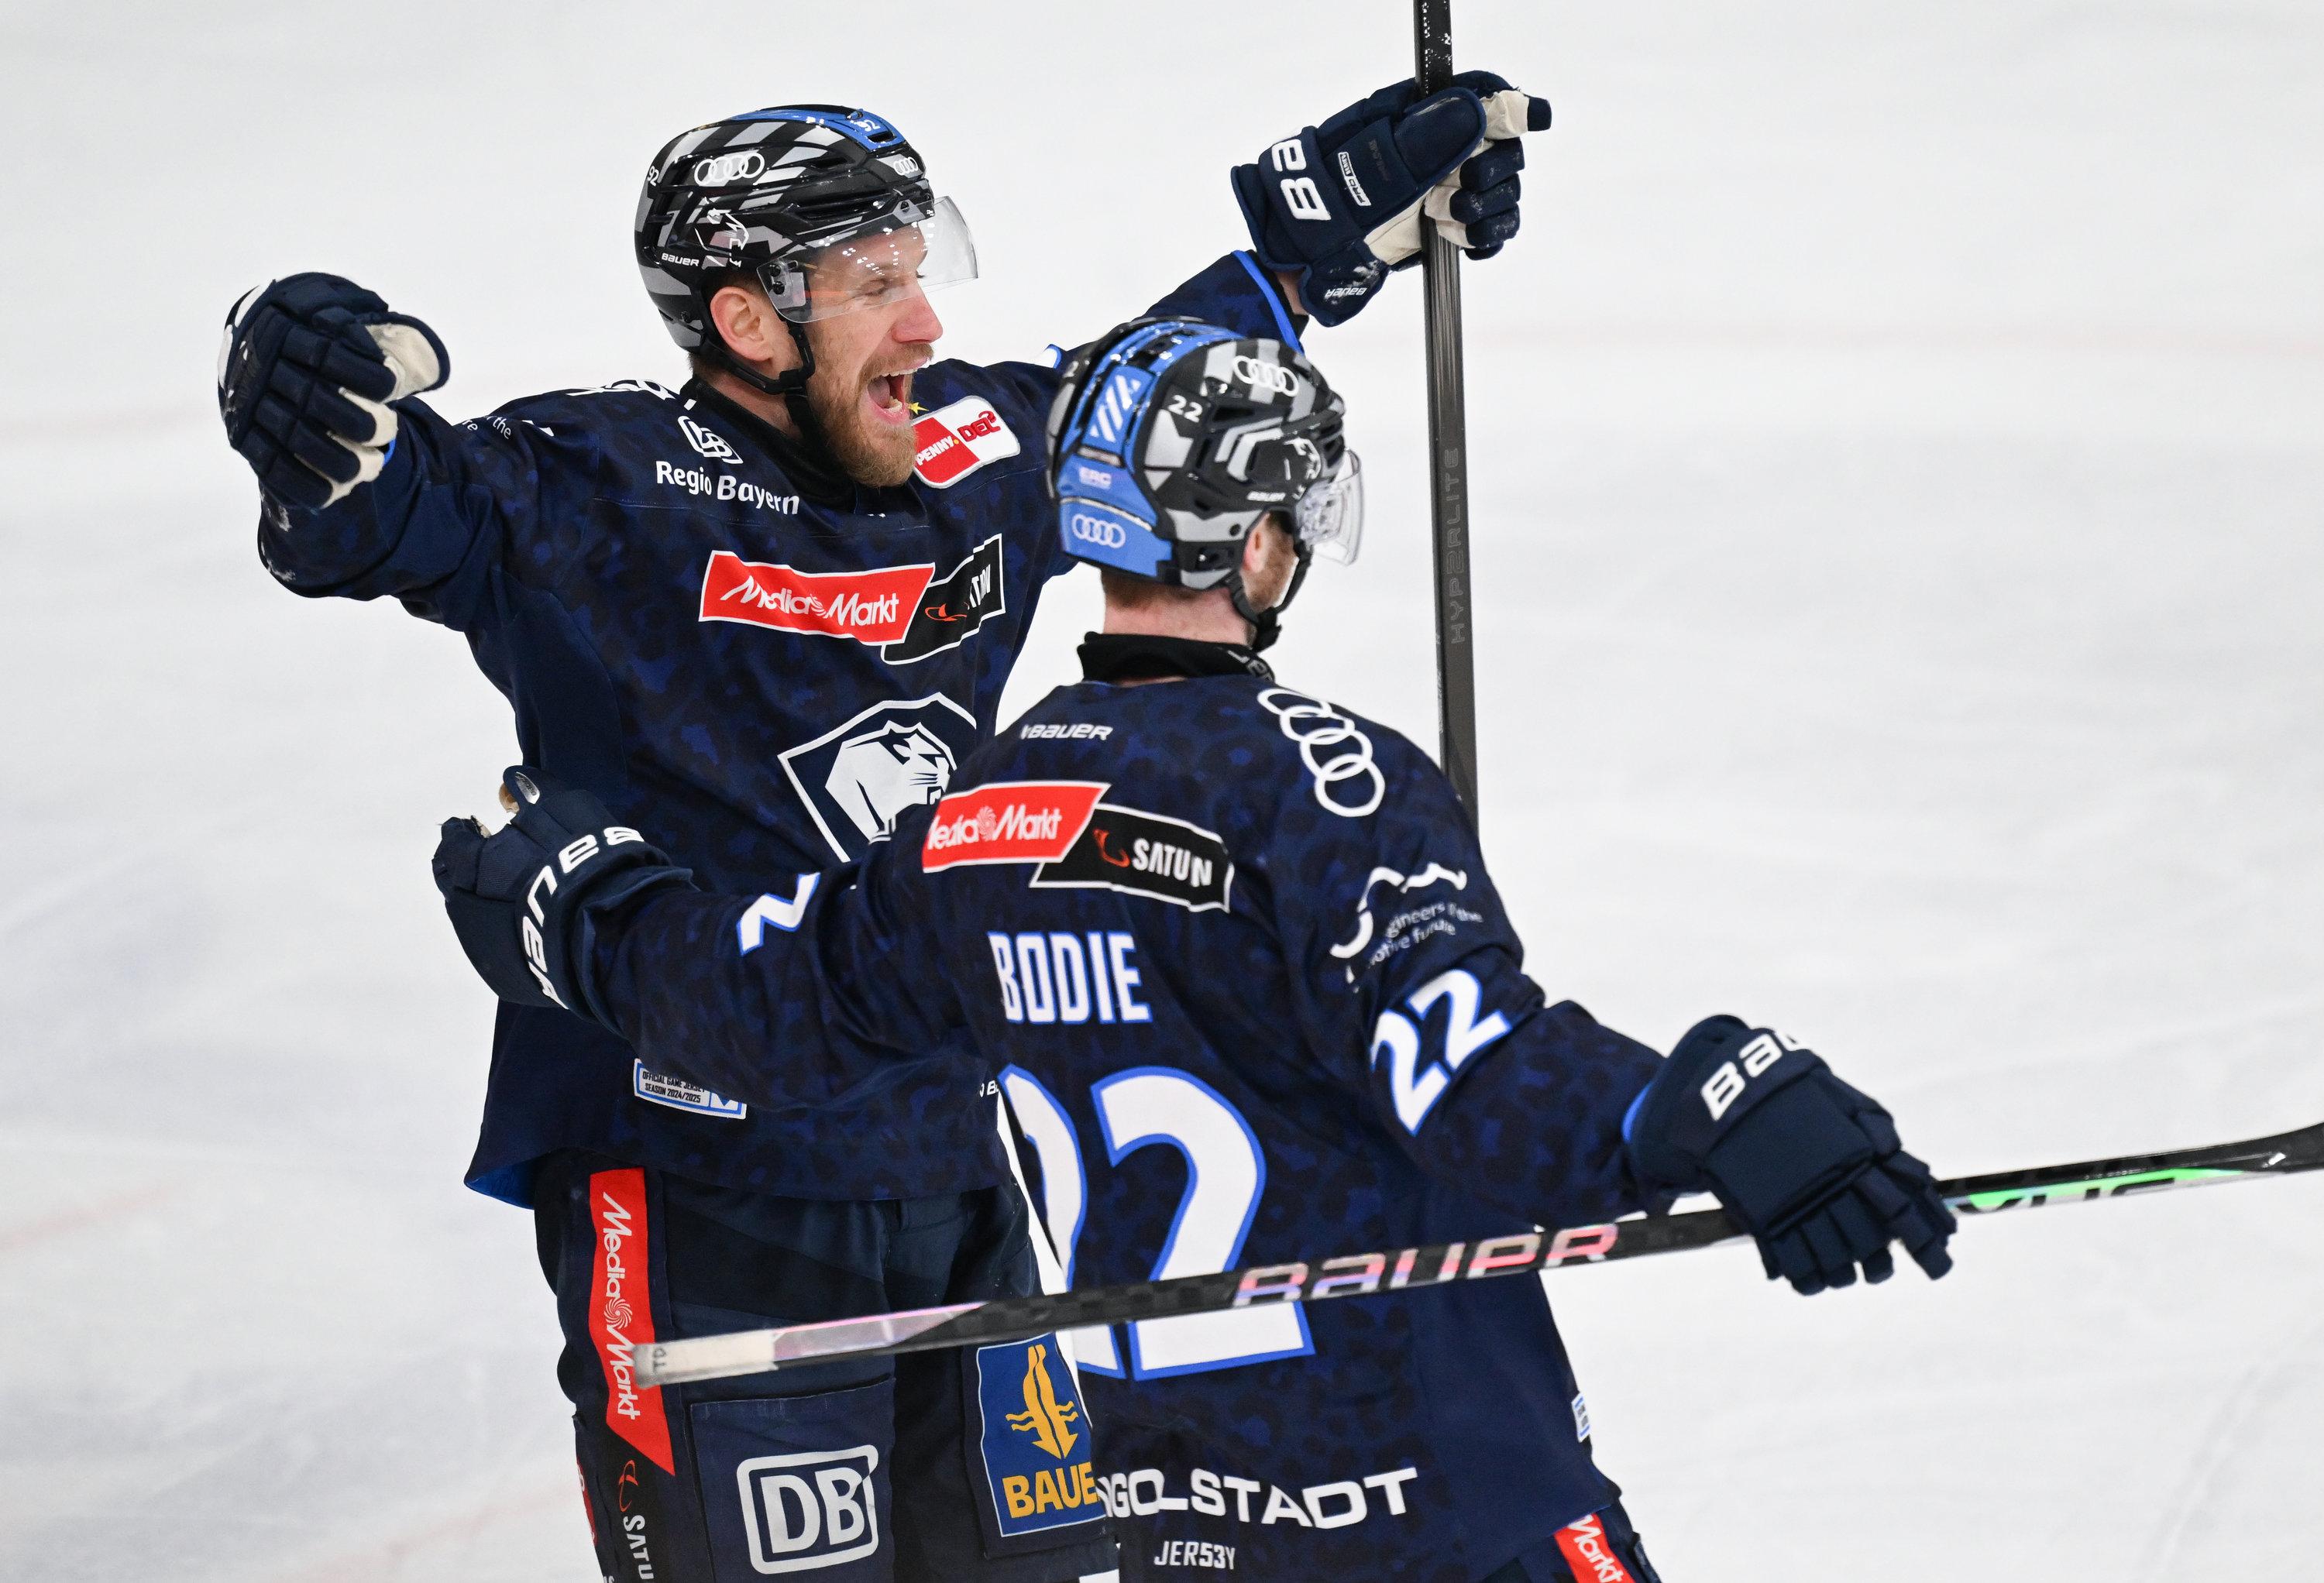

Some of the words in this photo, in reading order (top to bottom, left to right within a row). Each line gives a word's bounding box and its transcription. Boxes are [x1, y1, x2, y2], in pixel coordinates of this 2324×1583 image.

[648, 165, 659, 187] 92
[1348, 178, 1366, 204] PRO
[661, 252, 700, 266] BAUER
[1167, 394, 1203, 424] 22
[492, 417, 512, 440] the
[655, 461, 713, 496] Regio
[717, 475, 799, 515] Bayern
[987, 931, 1154, 1025] BODIE
[1370, 968, 1513, 1136] 22
[642, 1070, 666, 1084] OFFICIAL
[666, 1077, 682, 1089] GAME
[645, 1083, 667, 1095] SEASON
[667, 1088, 701, 1104] 2024/2025
[1002, 1461, 1099, 1519] BAUE
[1097, 1467, 1418, 1530] NGOLSTADT
[623, 1515, 655, 1580] SATU
